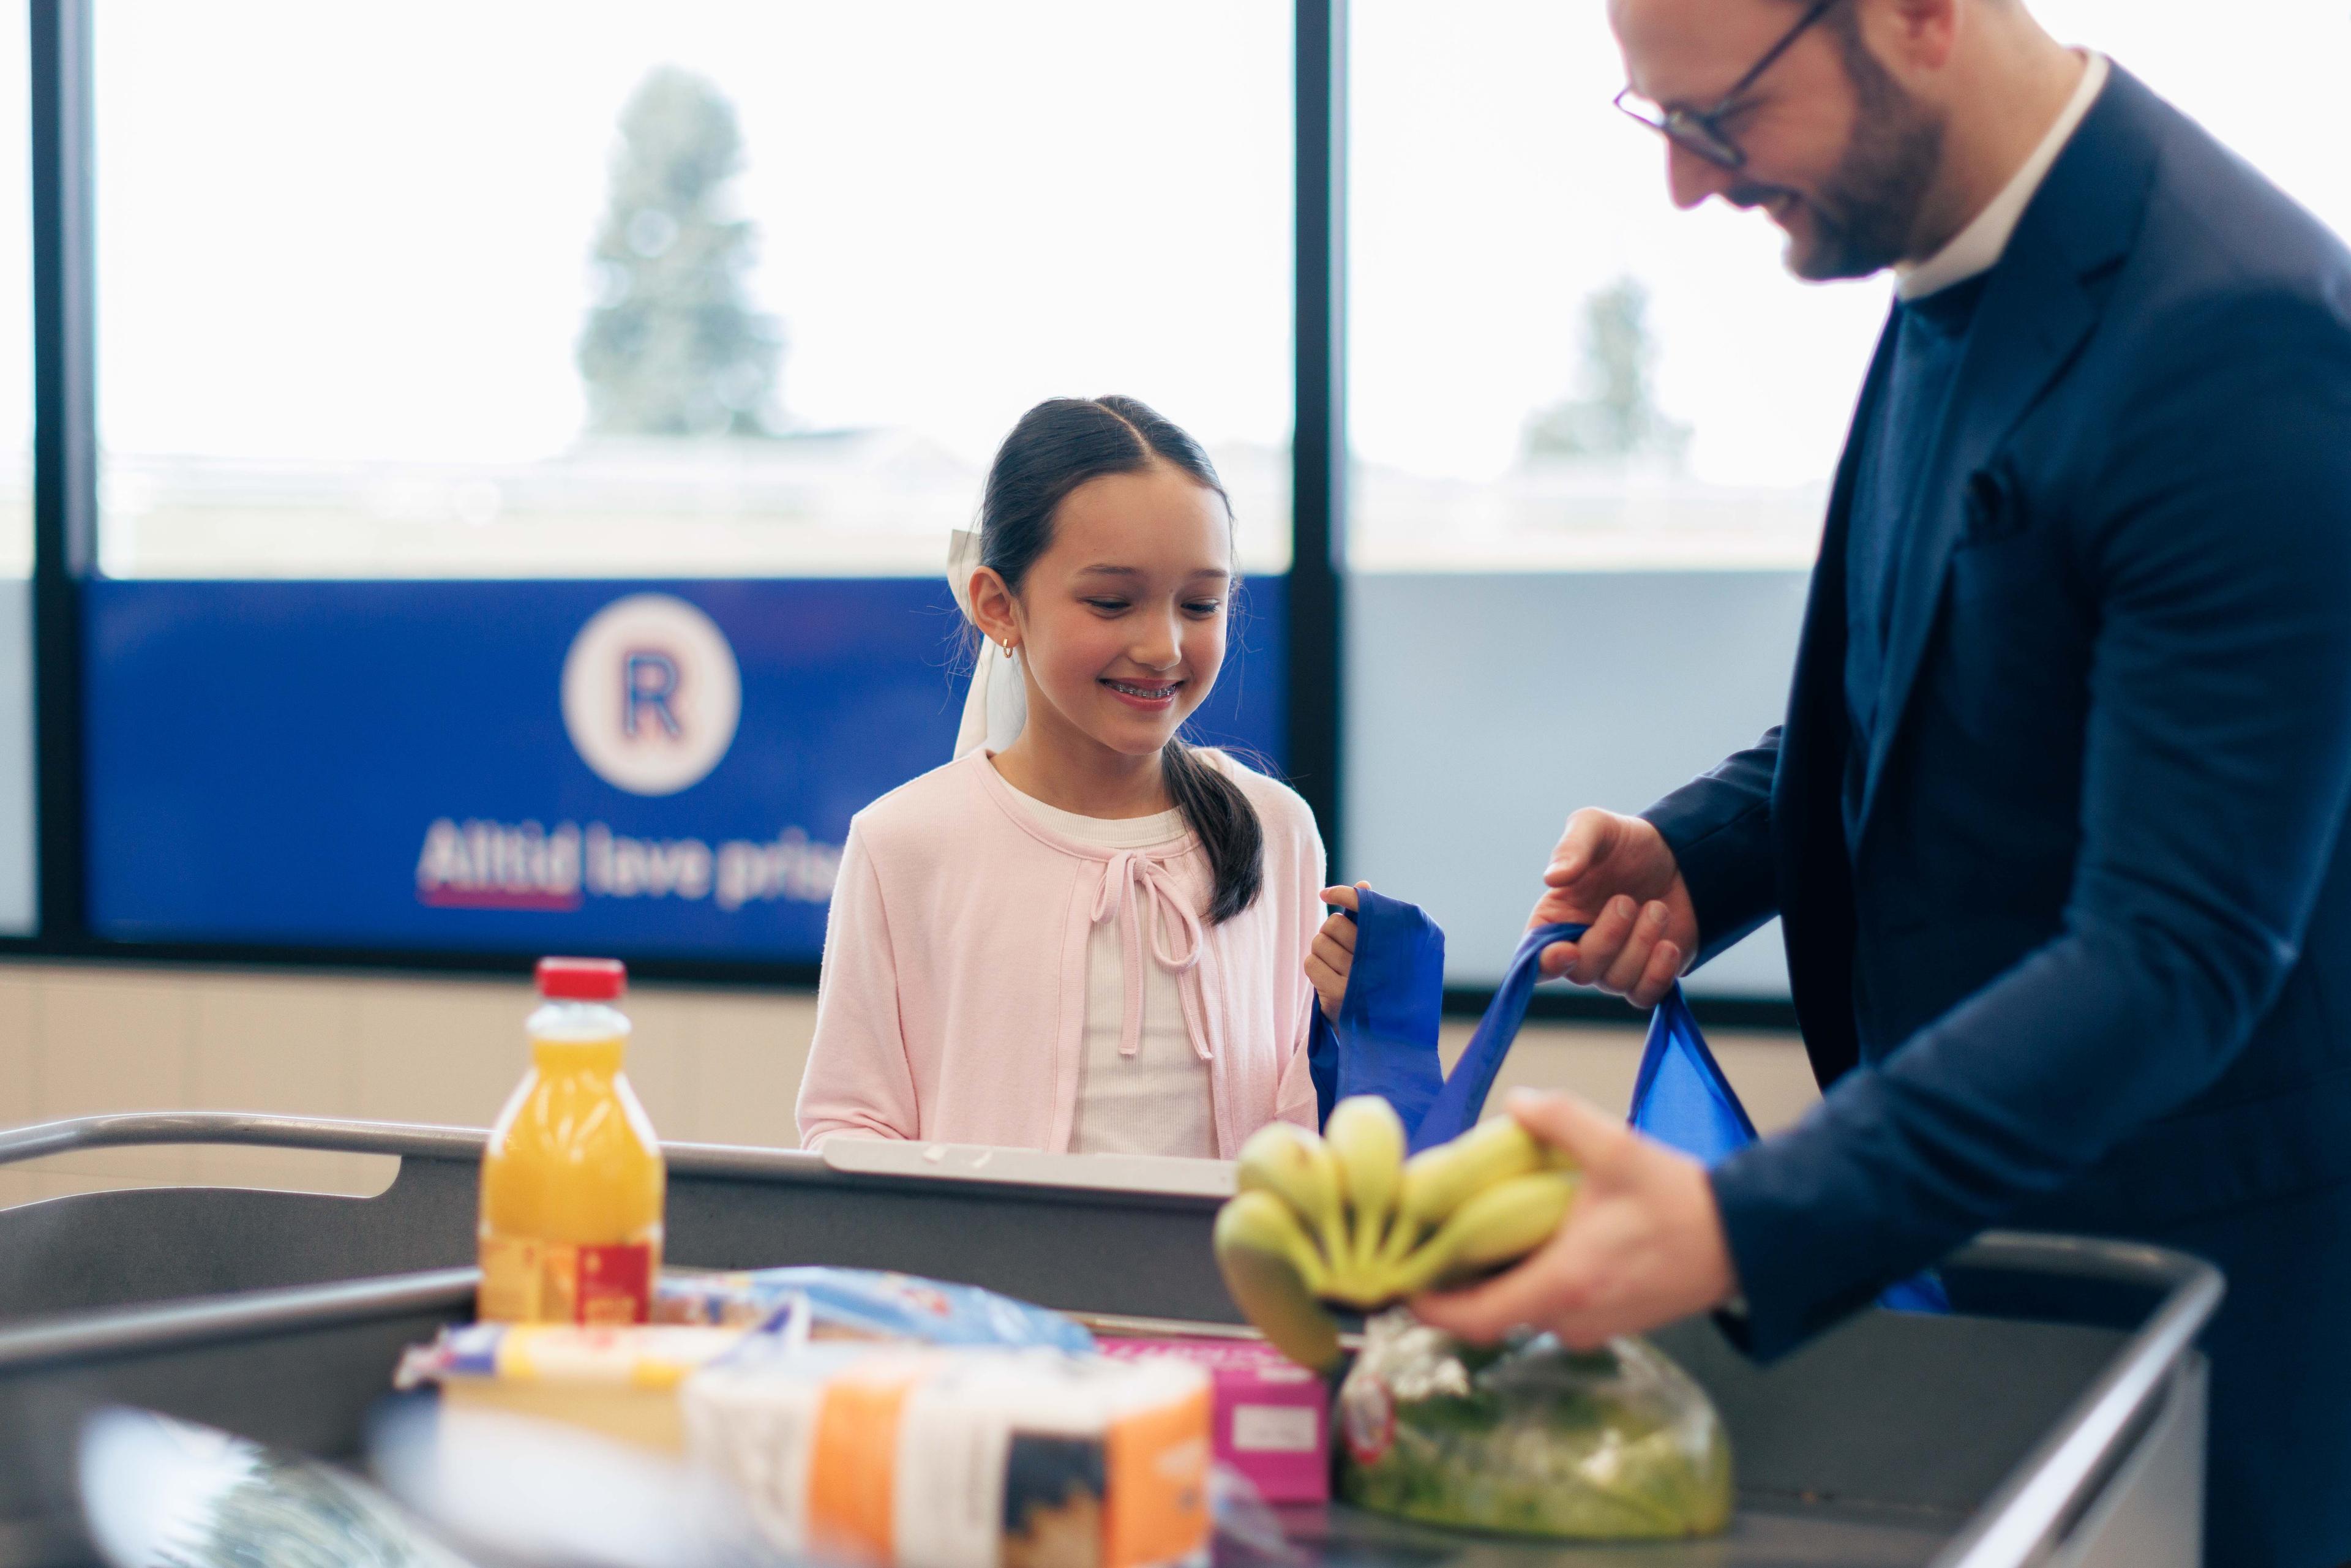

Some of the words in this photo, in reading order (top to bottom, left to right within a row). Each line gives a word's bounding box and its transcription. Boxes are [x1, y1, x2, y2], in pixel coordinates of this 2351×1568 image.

[622, 647, 681, 740] R
[419, 820, 582, 893] Alltid
[585, 823, 711, 898] lave
[716, 828, 844, 909] pris
